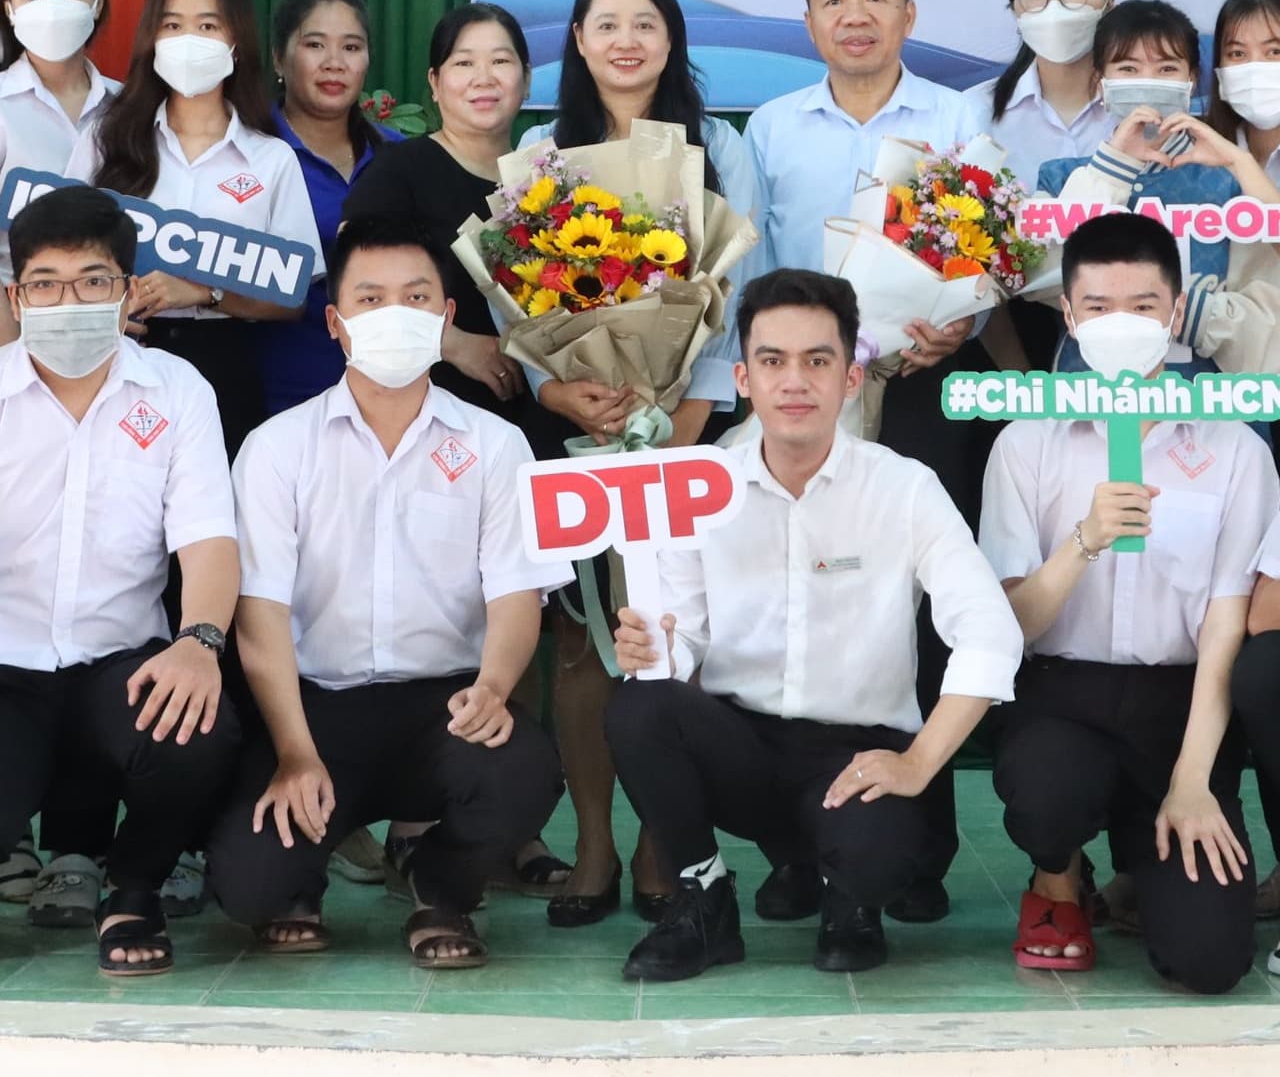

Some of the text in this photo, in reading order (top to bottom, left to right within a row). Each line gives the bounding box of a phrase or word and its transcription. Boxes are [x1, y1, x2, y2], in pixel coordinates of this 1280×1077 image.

[124, 208, 304, 296] PC1HN
[948, 377, 1045, 414] #Chi
[1055, 375, 1192, 415] Nhánh
[530, 459, 734, 551] DTP
